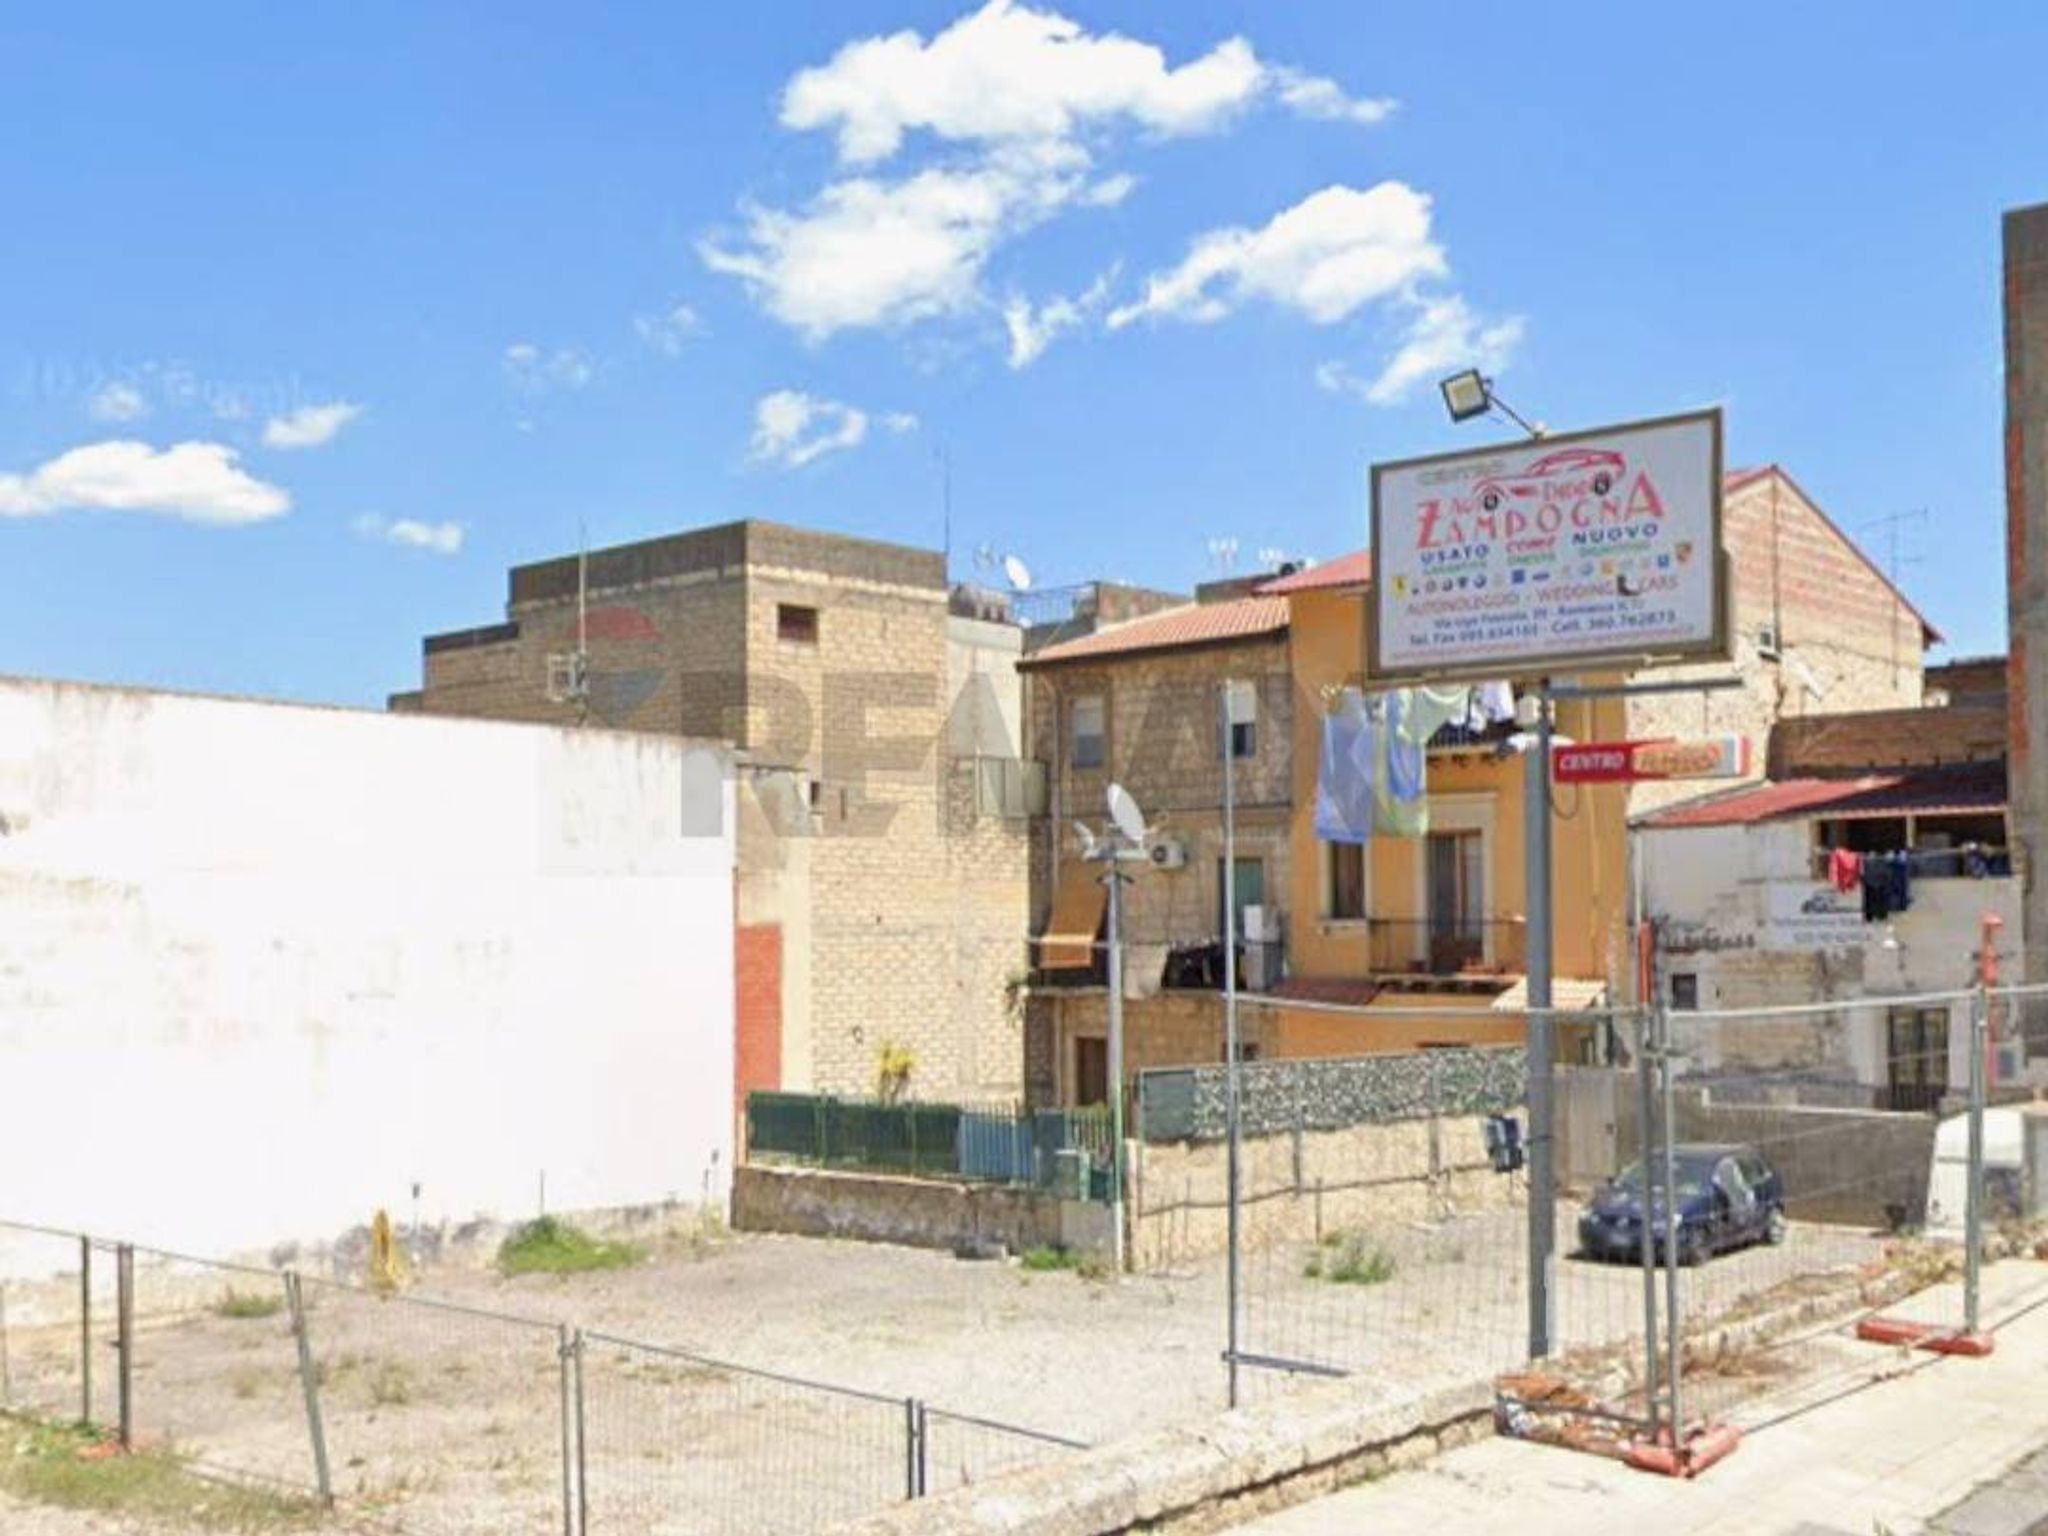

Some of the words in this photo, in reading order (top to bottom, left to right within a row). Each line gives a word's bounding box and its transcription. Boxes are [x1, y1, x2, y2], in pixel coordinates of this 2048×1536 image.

[1572, 522, 1658, 545] NUOVO
[1420, 544, 1490, 565] USATO
[1560, 752, 1625, 771] CENTRO
